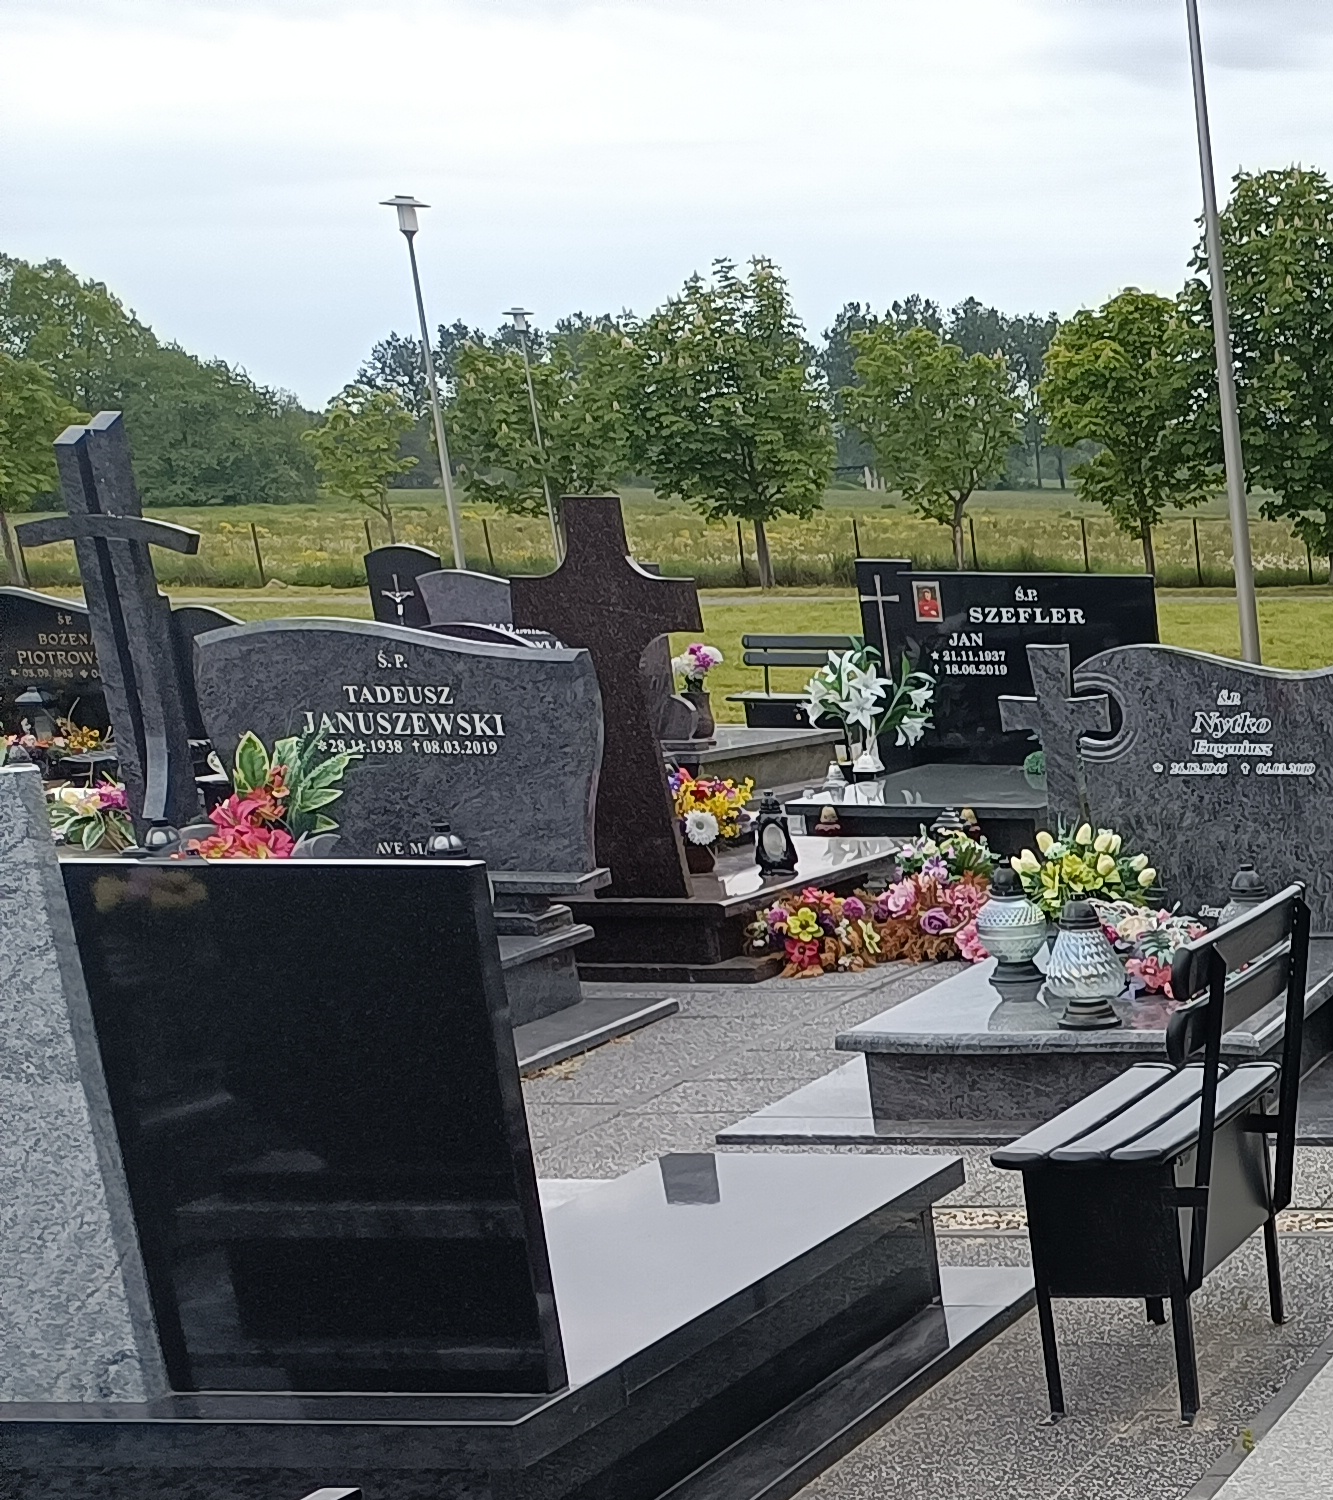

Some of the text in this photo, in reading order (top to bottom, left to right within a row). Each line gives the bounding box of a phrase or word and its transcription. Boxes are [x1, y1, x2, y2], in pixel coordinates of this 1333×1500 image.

[969, 607, 1086, 624] SZEFLER
[949, 632, 983, 646] JAN
[17, 650, 99, 665] PIOTROW
[342, 685, 454, 705] TADEUSZ
[302, 711, 506, 736] JANUSZEWSKI
[1191, 711, 1272, 738] Nytko
[422, 740, 498, 755] 08.03.2019
[376, 842, 405, 855] AVE
